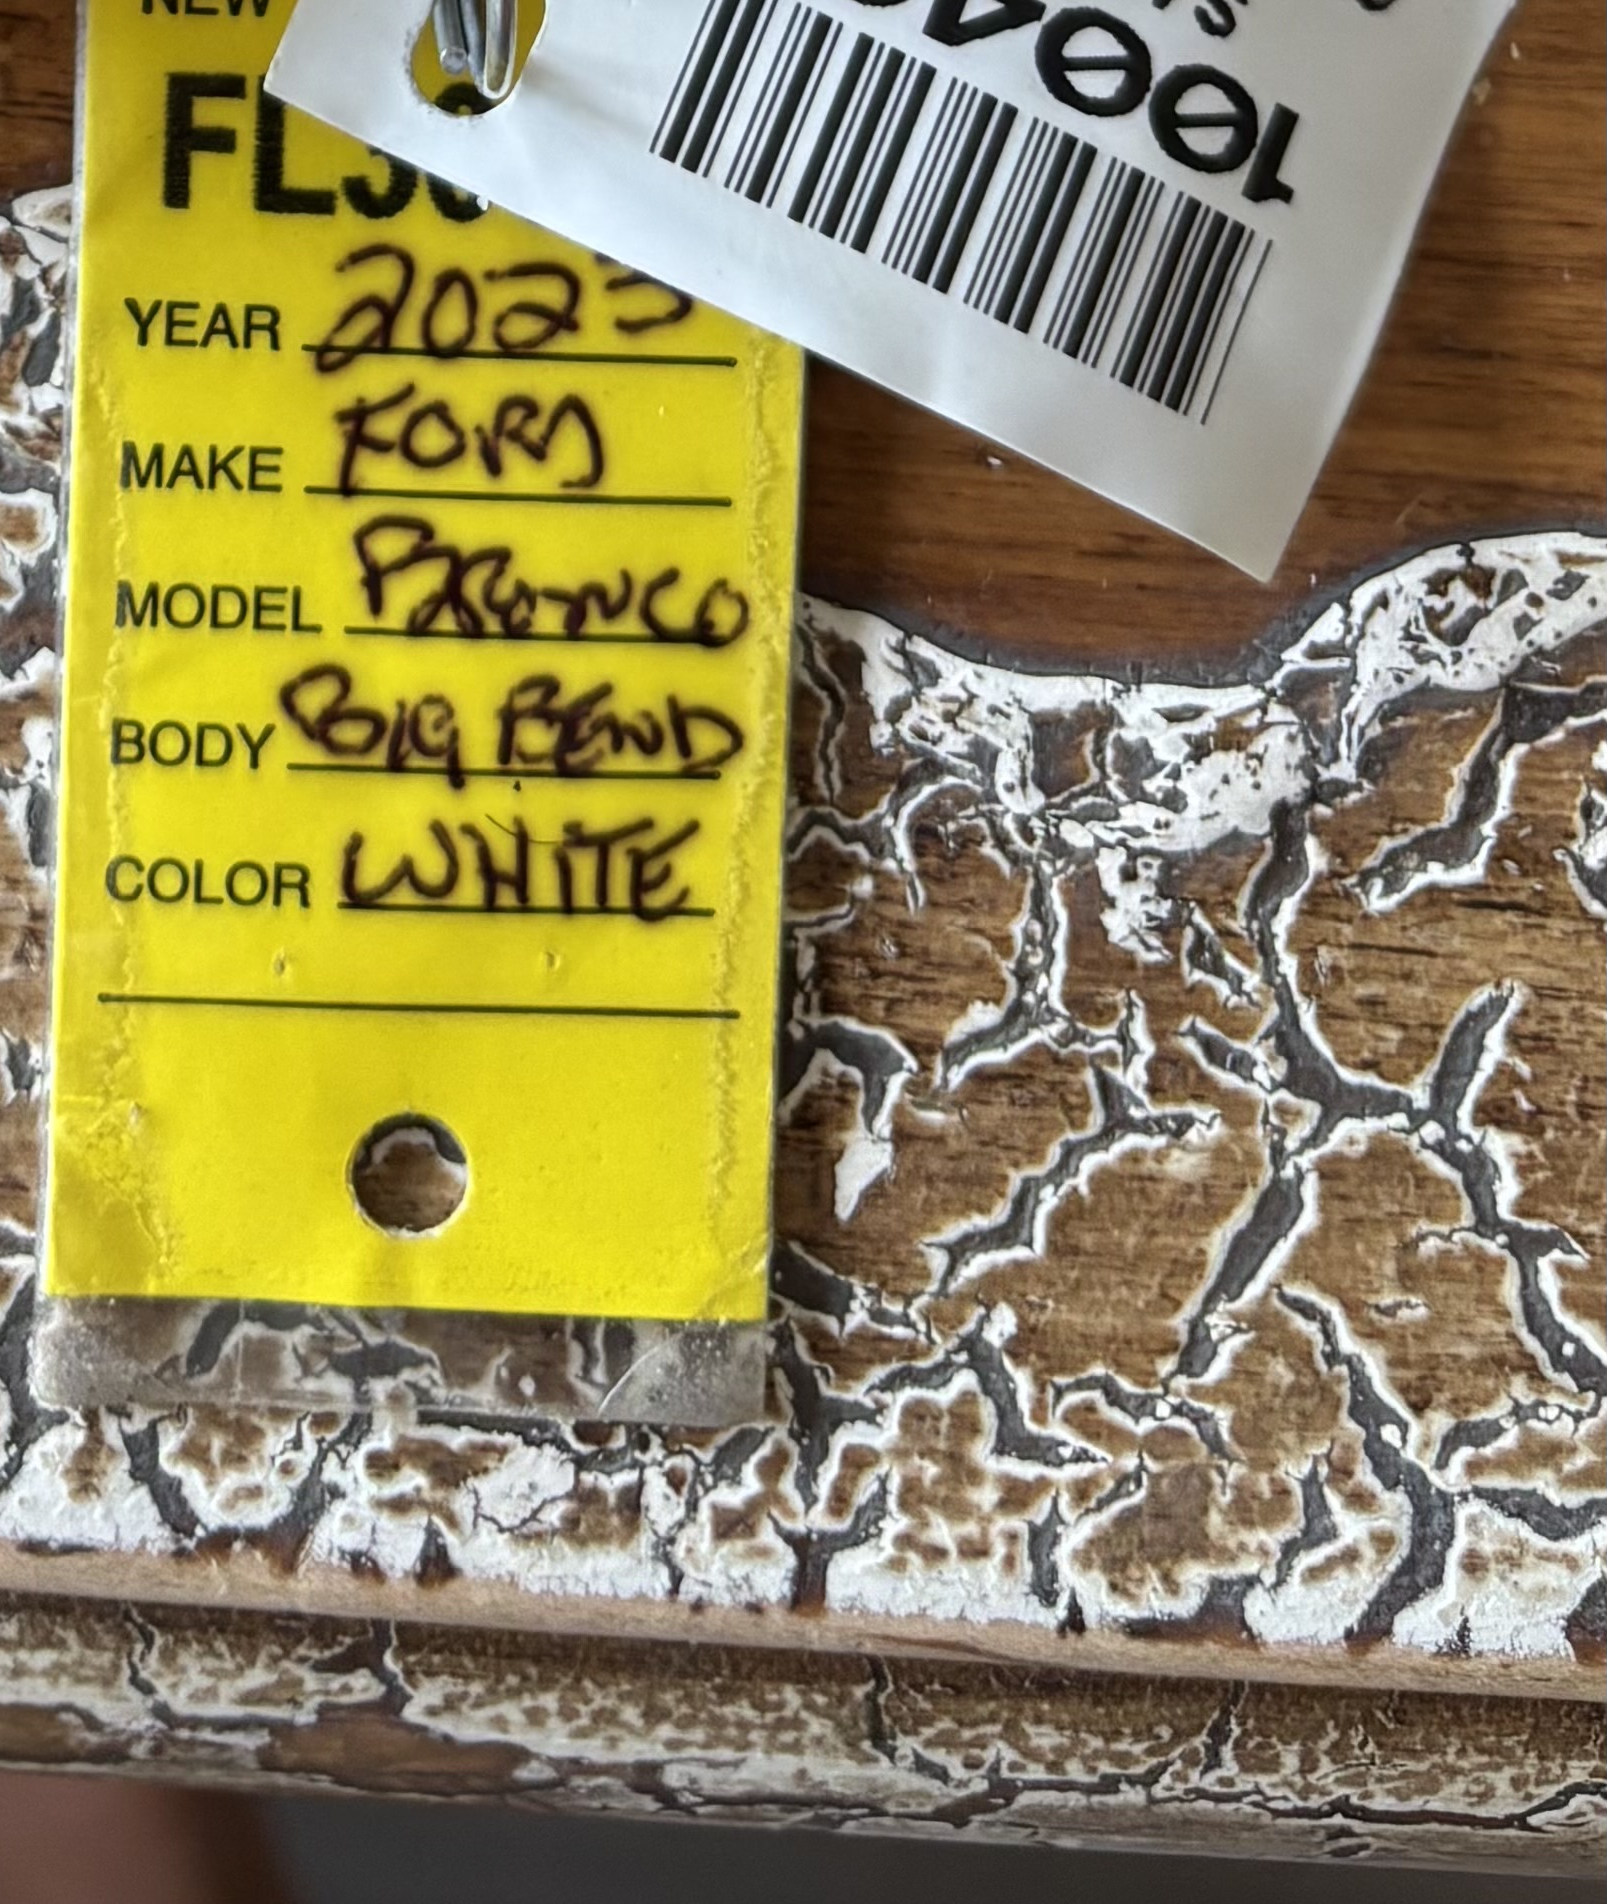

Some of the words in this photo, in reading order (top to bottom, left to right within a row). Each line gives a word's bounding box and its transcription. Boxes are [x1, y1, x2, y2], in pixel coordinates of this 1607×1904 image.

[124, 297, 282, 352] YEAR
[118, 440, 285, 495] MAKE
[114, 579, 323, 635] MODEL
[109, 720, 277, 771] BODY
[104, 854, 311, 909] COLOR
[340, 816, 701, 924] WHITE
